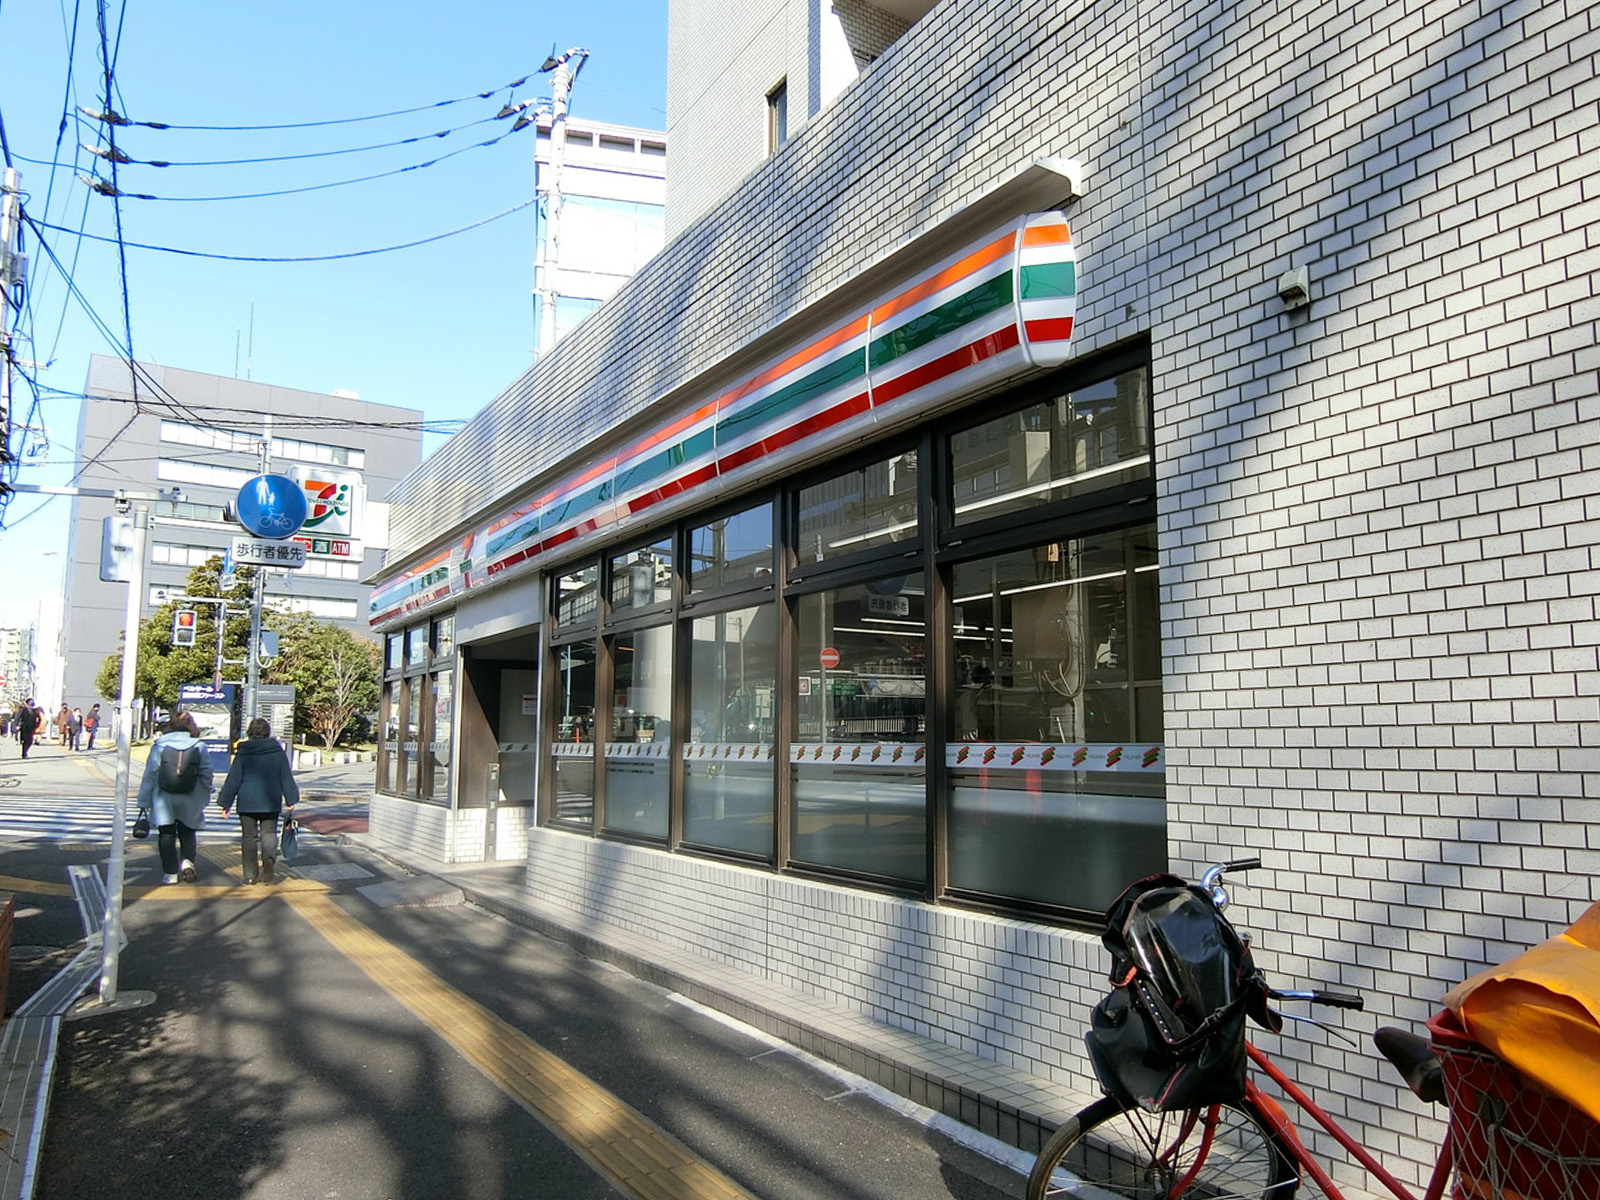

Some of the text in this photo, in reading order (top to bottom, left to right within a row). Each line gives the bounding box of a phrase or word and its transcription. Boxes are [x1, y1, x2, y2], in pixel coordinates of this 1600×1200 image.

[236, 543, 303, 561] 歩行者優先
[331, 542, 349, 555] ATM
